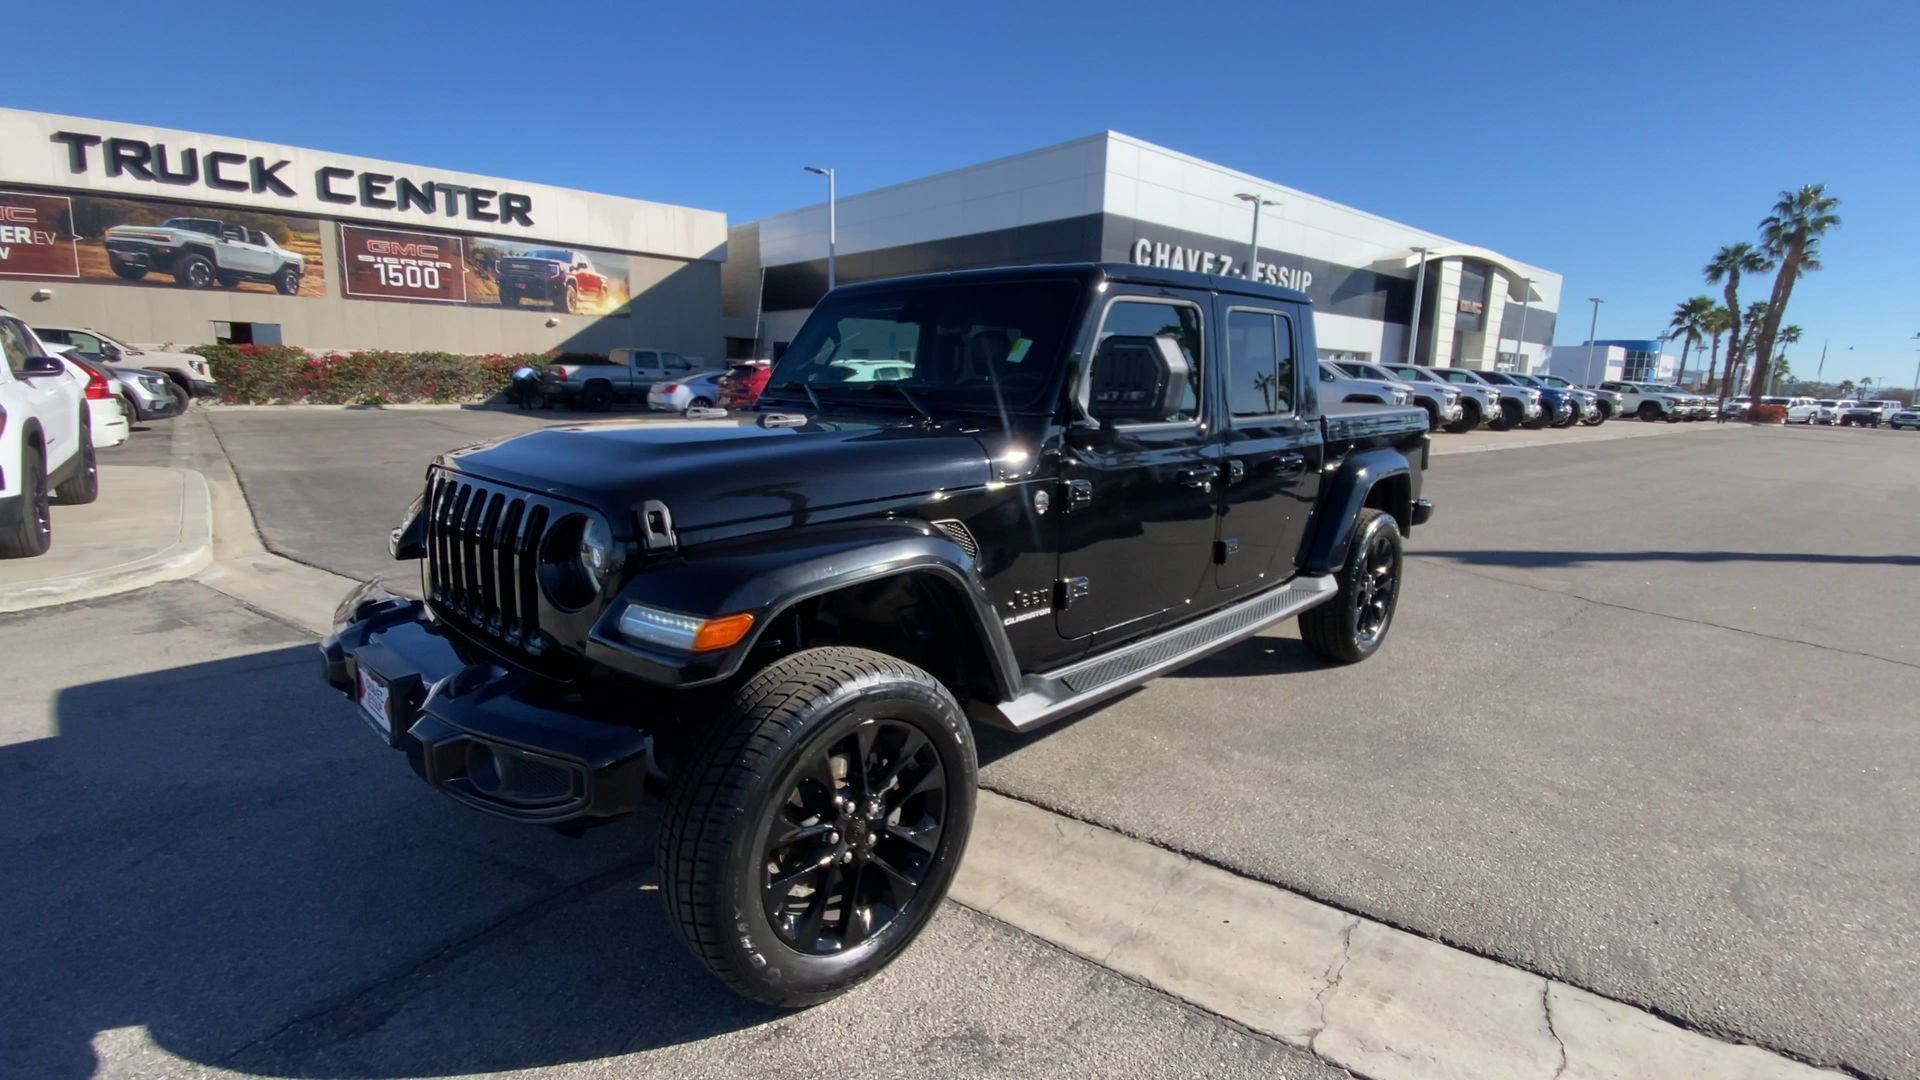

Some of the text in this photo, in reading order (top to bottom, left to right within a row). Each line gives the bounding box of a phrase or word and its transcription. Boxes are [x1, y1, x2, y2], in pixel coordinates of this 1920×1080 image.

[50, 131, 534, 226] TRUCK CENTER
[367, 240, 439, 259] GMC
[357, 254, 452, 269] SIERRA
[373, 263, 439, 289] 1500
